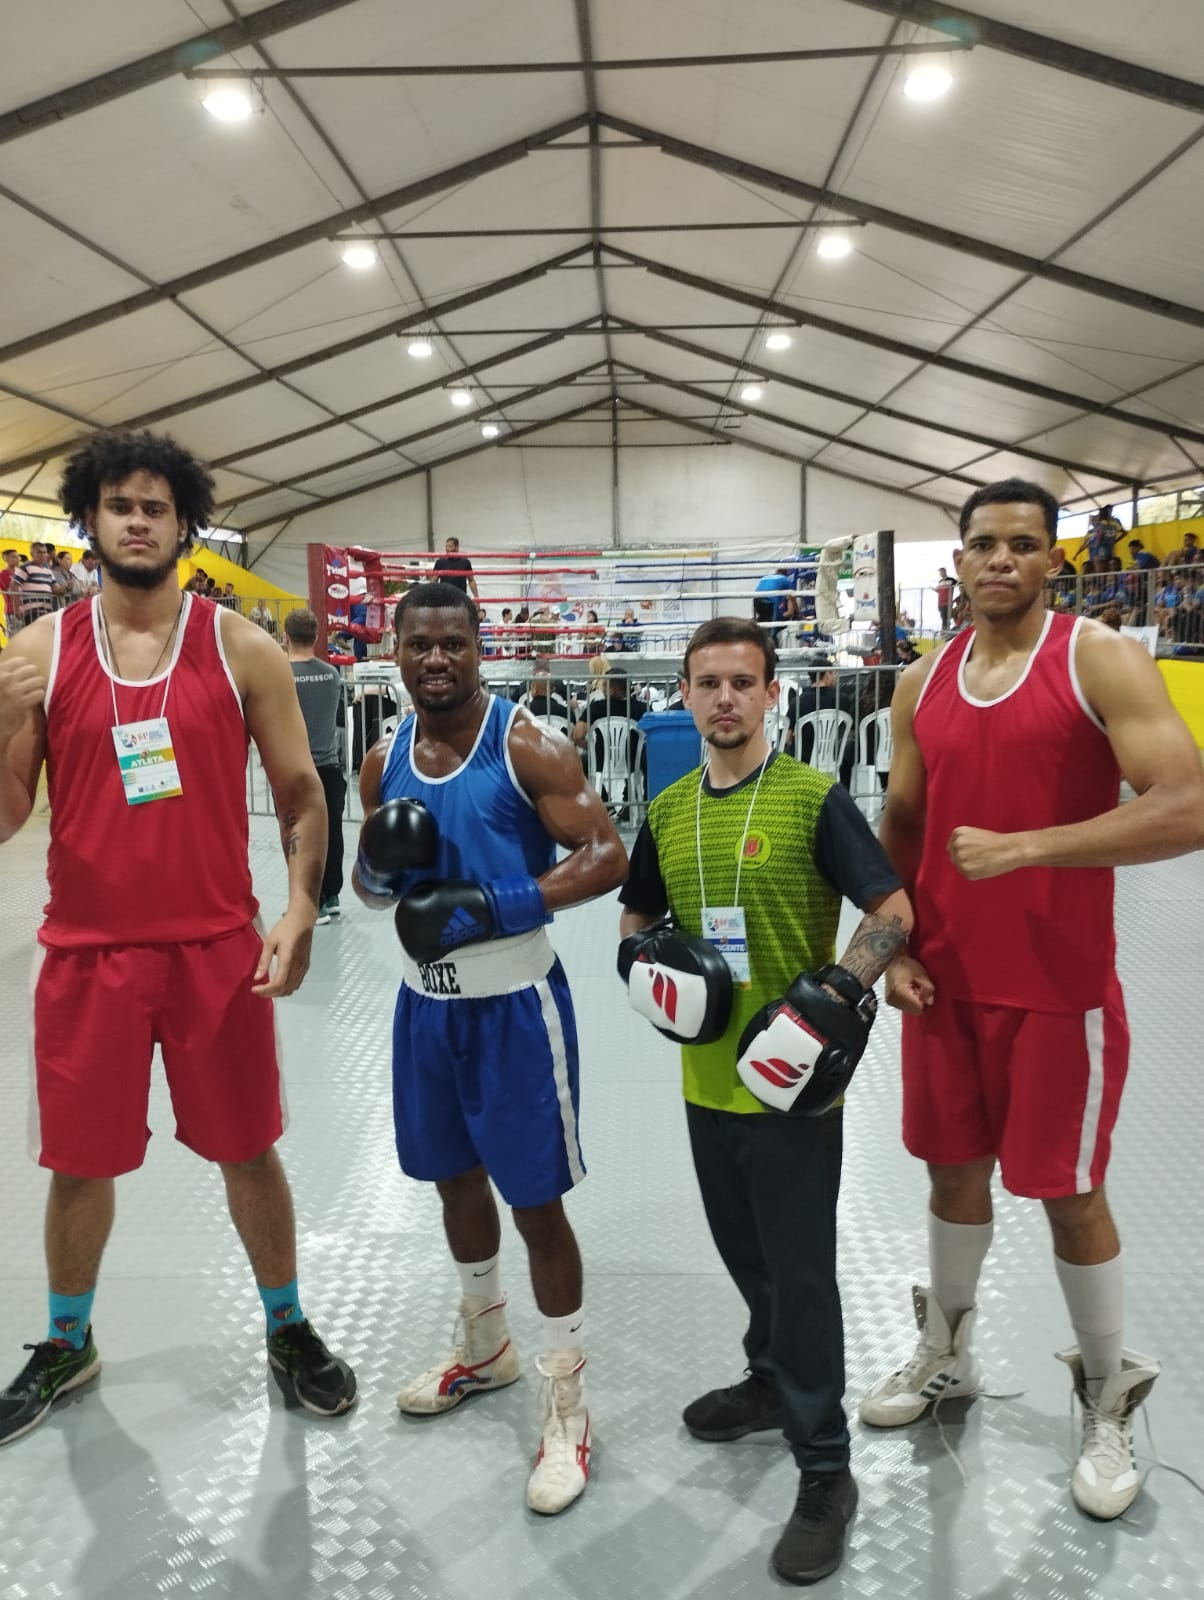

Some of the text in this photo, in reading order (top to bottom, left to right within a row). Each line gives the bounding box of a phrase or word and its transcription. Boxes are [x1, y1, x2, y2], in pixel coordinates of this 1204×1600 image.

[294, 673, 334, 683] ROFESSOR
[130, 755, 165, 769] ATLETA
[418, 960, 462, 995] BOXE
